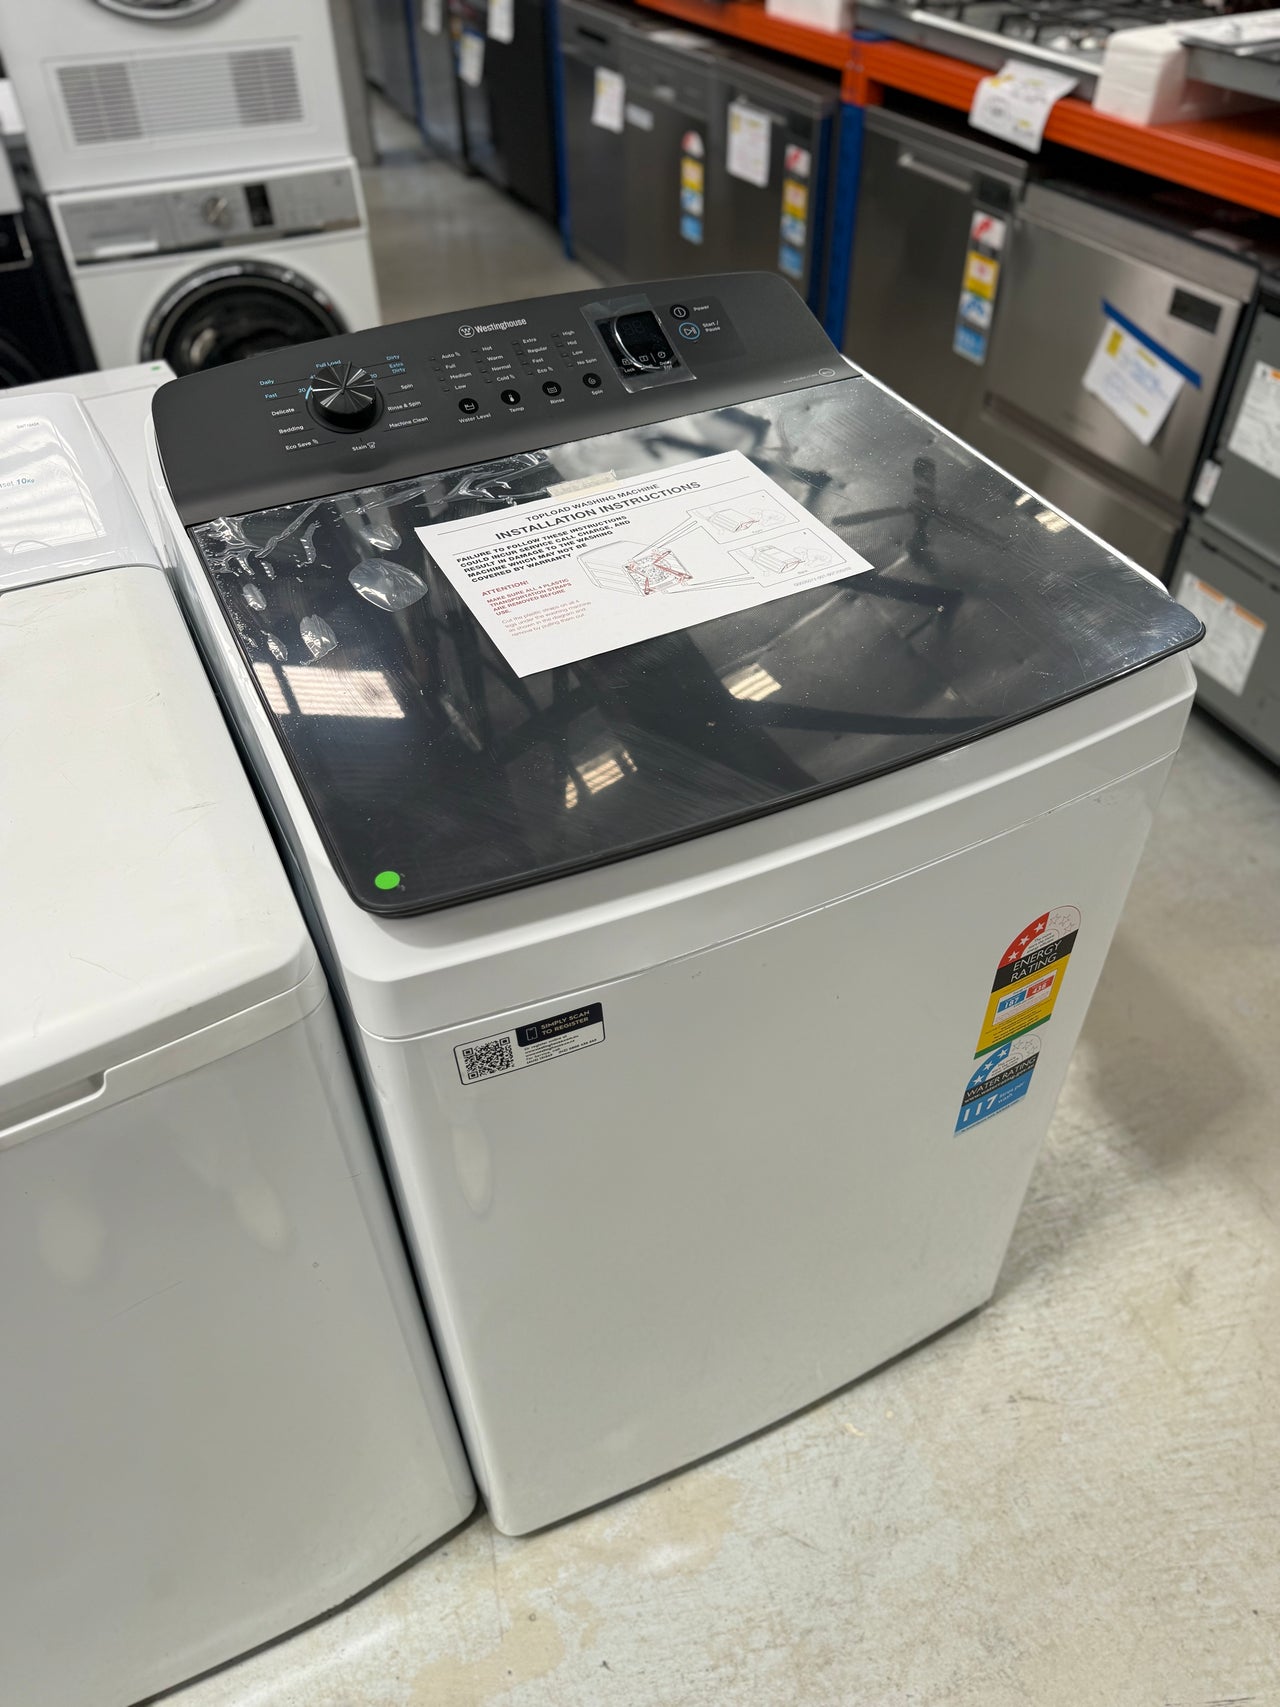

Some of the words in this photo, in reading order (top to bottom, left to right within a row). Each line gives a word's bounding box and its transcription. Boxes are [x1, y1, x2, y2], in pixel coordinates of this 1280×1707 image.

[474, 318, 527, 334] Westinghouse
[527, 346, 547, 354] Regular
[326, 359, 341, 367] Load
[491, 363, 511, 371] Normal
[259, 379, 274, 387] Daily
[450, 372, 472, 380] Medium
[271, 408, 295, 416] Delicate
[476, 412, 491, 420] Level
[279, 425, 304, 434] Bedding
[389, 420, 412, 428] Machine
[412, 416, 429, 424] Clean
[495, 509, 597, 540] INSTALLATION
[598, 481, 701, 513] INSTRUCTIONS
[525, 506, 571, 522] TOPLOAD
[571, 494, 616, 509] WASHING
[616, 484, 660, 498] MACHINE
[457, 551, 491, 563] FAILURE
[507, 538, 540, 550] FOLLOW
[541, 530, 569, 541] THESE
[569, 515, 627, 534] INSTRUCTIONS
[460, 557, 490, 568] COULD
[491, 550, 518, 560] INCUR
[519, 541, 554, 553] SERVICE
[555, 535, 576, 543] CALL
[577, 525, 614, 537] CHARGE,
[464, 561, 496, 573] RESULT
[509, 549, 544, 561] DAMAGE
[559, 540, 576, 548] THE
[576, 530, 613, 543] WASHING
[467, 564, 507, 578] MACHINE
[508, 556, 536, 567] WHICH
[537, 551, 555, 560] MAY
[472, 569, 512, 583] COVERED
[526, 553, 572, 568] WARRANTY
[482, 580, 529, 597] ATTENTION!
[486, 595, 506, 604] MAKE
[506, 590, 524, 598] SURE
[543, 578, 570, 589] PLASTIC
[489, 590, 547, 608] TRANSPORTATION
[547, 582, 572, 592] STRAPS
[507, 596, 539, 608] REMOVED
[540, 589, 566, 599] BEFORE
[519, 617, 535, 626] under
[546, 608, 568, 618] washing
[523, 610, 541, 620] plastic
[552, 610, 575, 621] diagram
[541, 620, 560, 630] pulling
[1013, 940, 1063, 972] ENERGY
[1011, 952, 1057, 982] RATING
[541, 1017, 567, 1030] SIMPLY
[568, 1010, 590, 1020] SCAN
[554, 1017, 589, 1031] REGISTER
[967, 1076, 1000, 1097] WATER
[1002, 1058, 1035, 1080] RATING
[963, 1094, 998, 1122] 117
